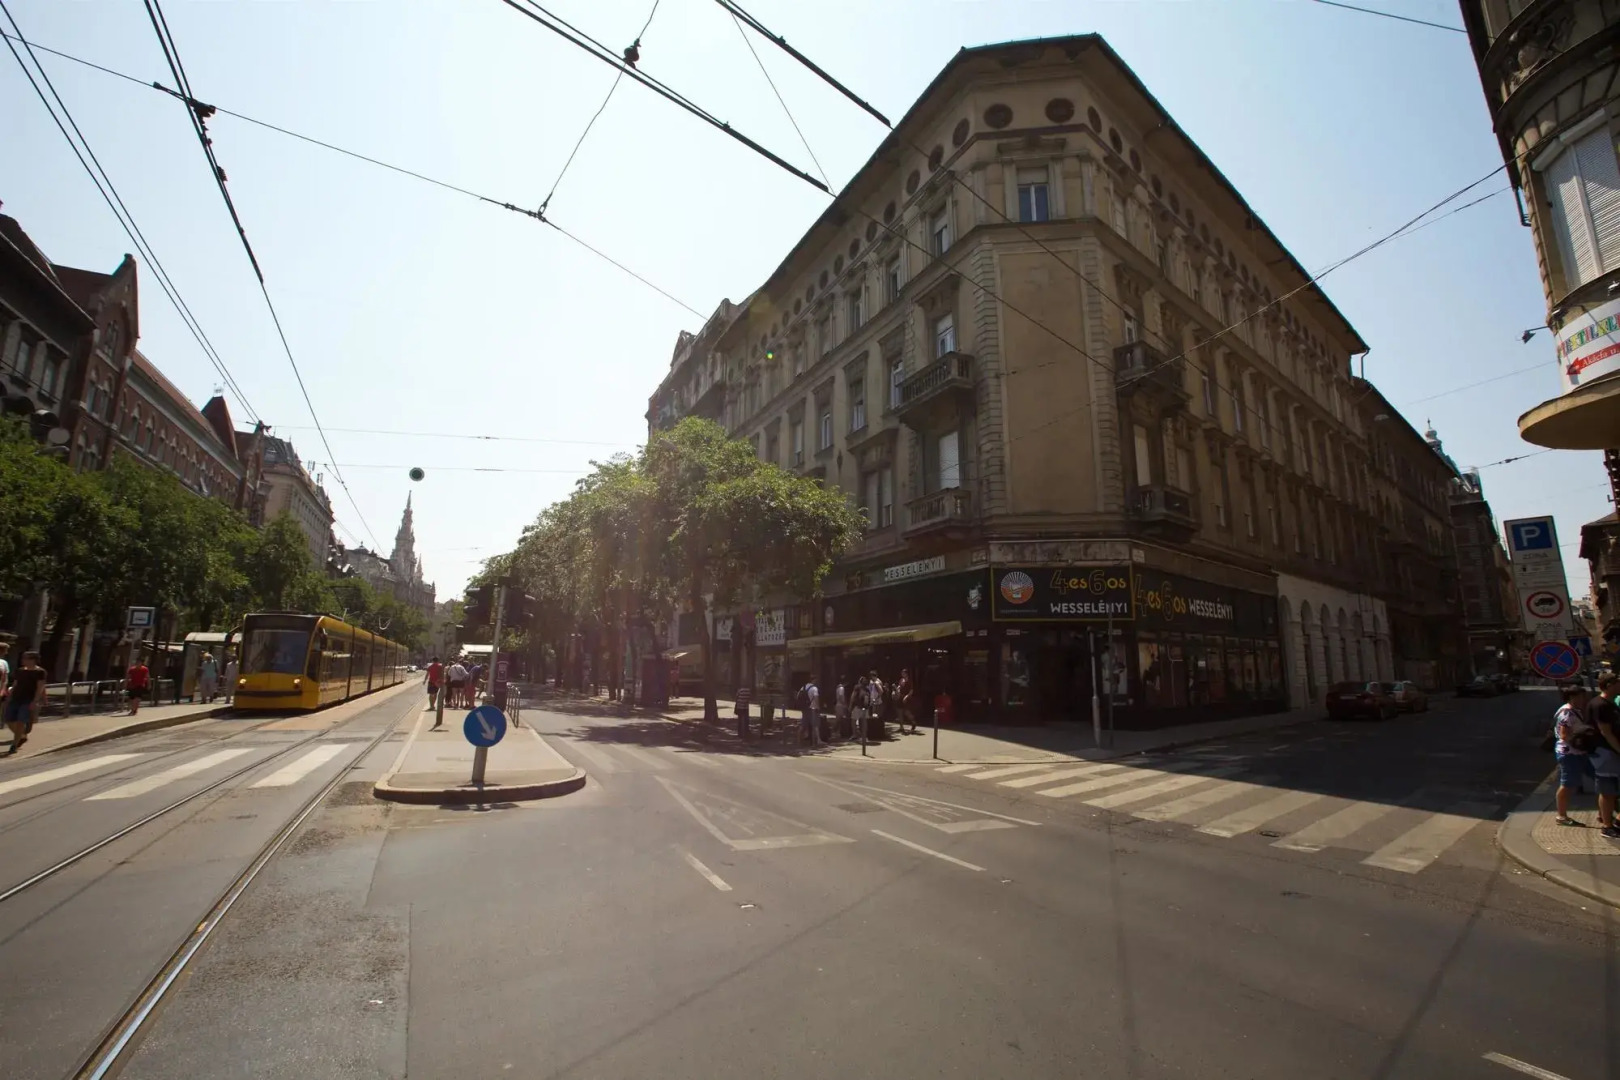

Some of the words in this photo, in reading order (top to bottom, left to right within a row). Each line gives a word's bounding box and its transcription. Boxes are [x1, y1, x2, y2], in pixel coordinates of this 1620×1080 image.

[1519, 525, 1541, 548] P
[1049, 599, 1128, 615] WESSELÉNYI
[1188, 596, 1234, 621] WESSELÉNYI
